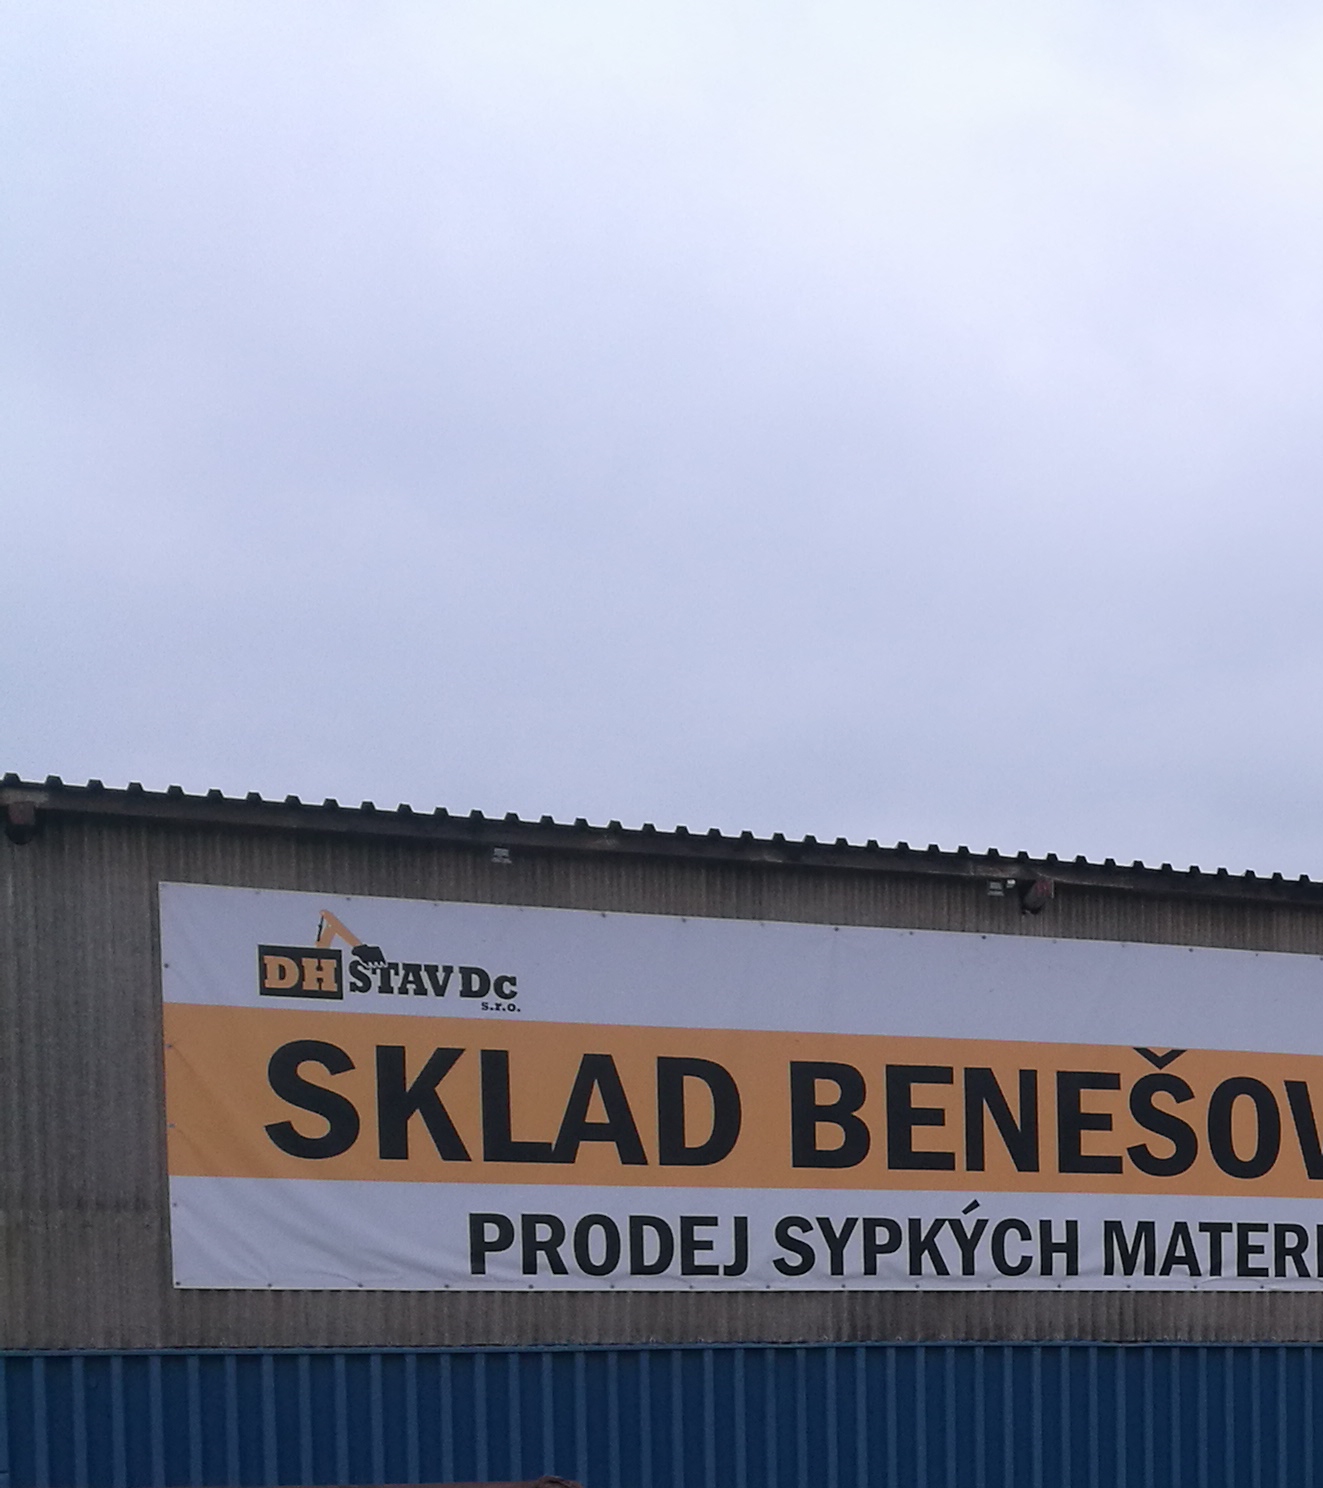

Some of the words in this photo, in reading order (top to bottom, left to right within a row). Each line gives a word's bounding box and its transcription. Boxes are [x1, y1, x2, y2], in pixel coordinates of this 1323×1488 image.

[263, 954, 338, 992] DH
[481, 1001, 521, 1013] s.r.o.
[263, 1039, 742, 1167] SKLAD
[468, 1212, 749, 1277] PRODEJ
[772, 1199, 1079, 1277] SYPKÝCH
